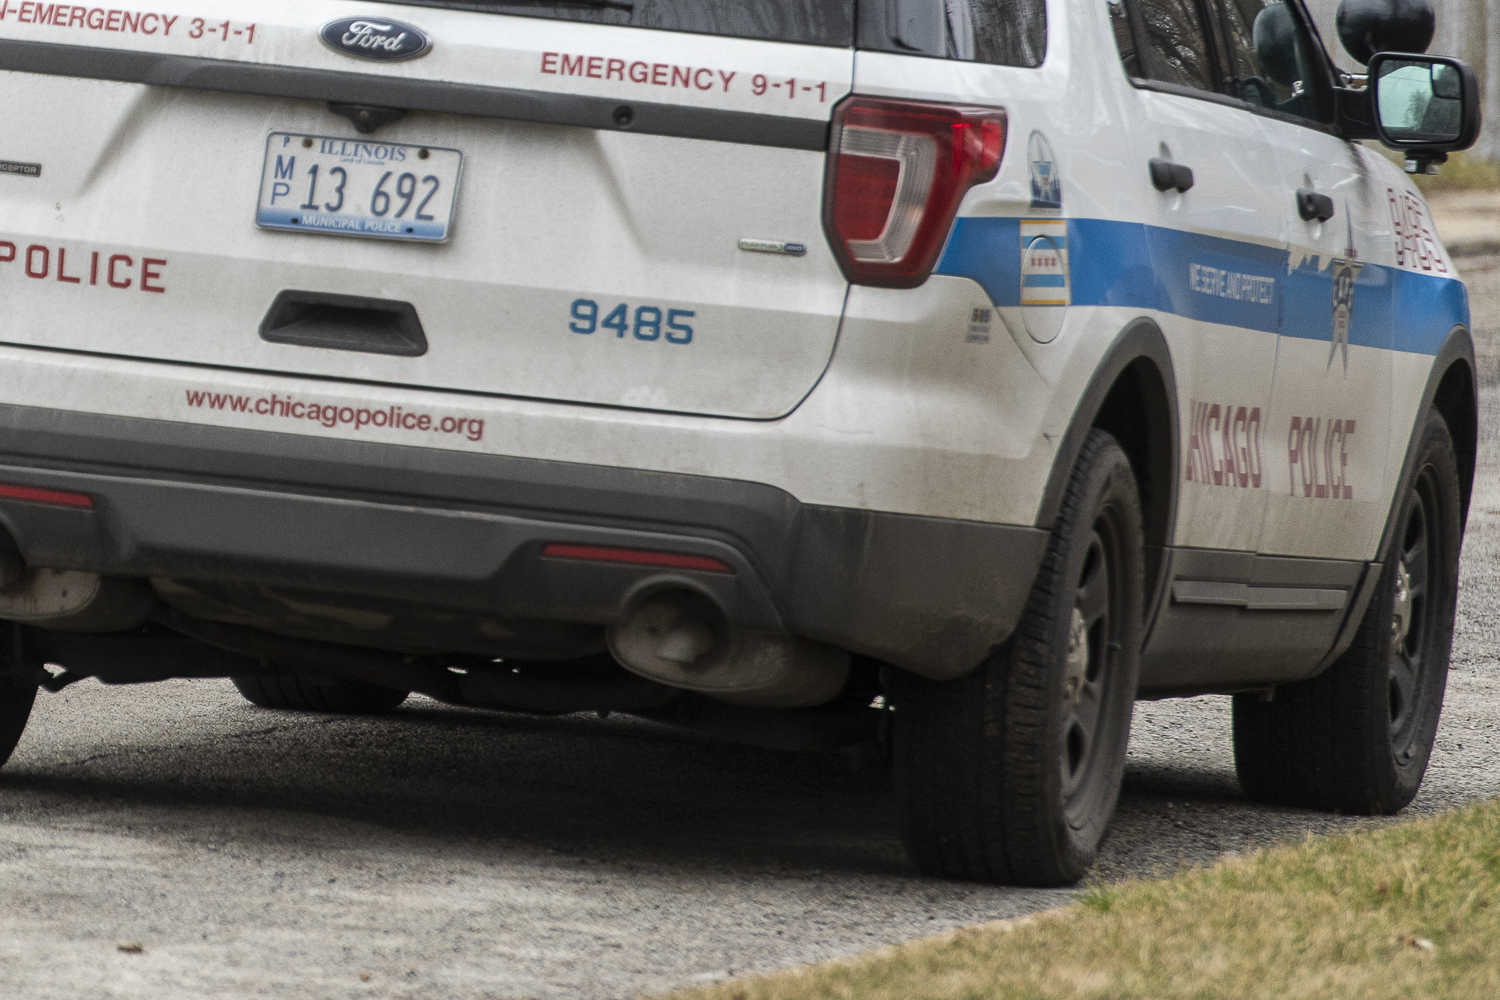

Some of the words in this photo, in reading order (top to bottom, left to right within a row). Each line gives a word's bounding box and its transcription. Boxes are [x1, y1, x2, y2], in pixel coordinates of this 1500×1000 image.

[187, 16, 257, 45] 3-1-1
[341, 20, 407, 51] Ford
[540, 51, 736, 93] EMERGENCY
[751, 73, 828, 103] 9-1-1
[319, 139, 407, 162] ILLINOIS
[300, 163, 347, 213] 13
[369, 170, 440, 222] 692
[301, 214, 362, 231] MUNICIPAL
[364, 219, 402, 234] POLICE
[568, 298, 696, 345] 9485
[185, 389, 485, 442] www.chicagopolice.org
[1186, 399, 1261, 489] HICAGO
[1287, 415, 1357, 500] POLICE
